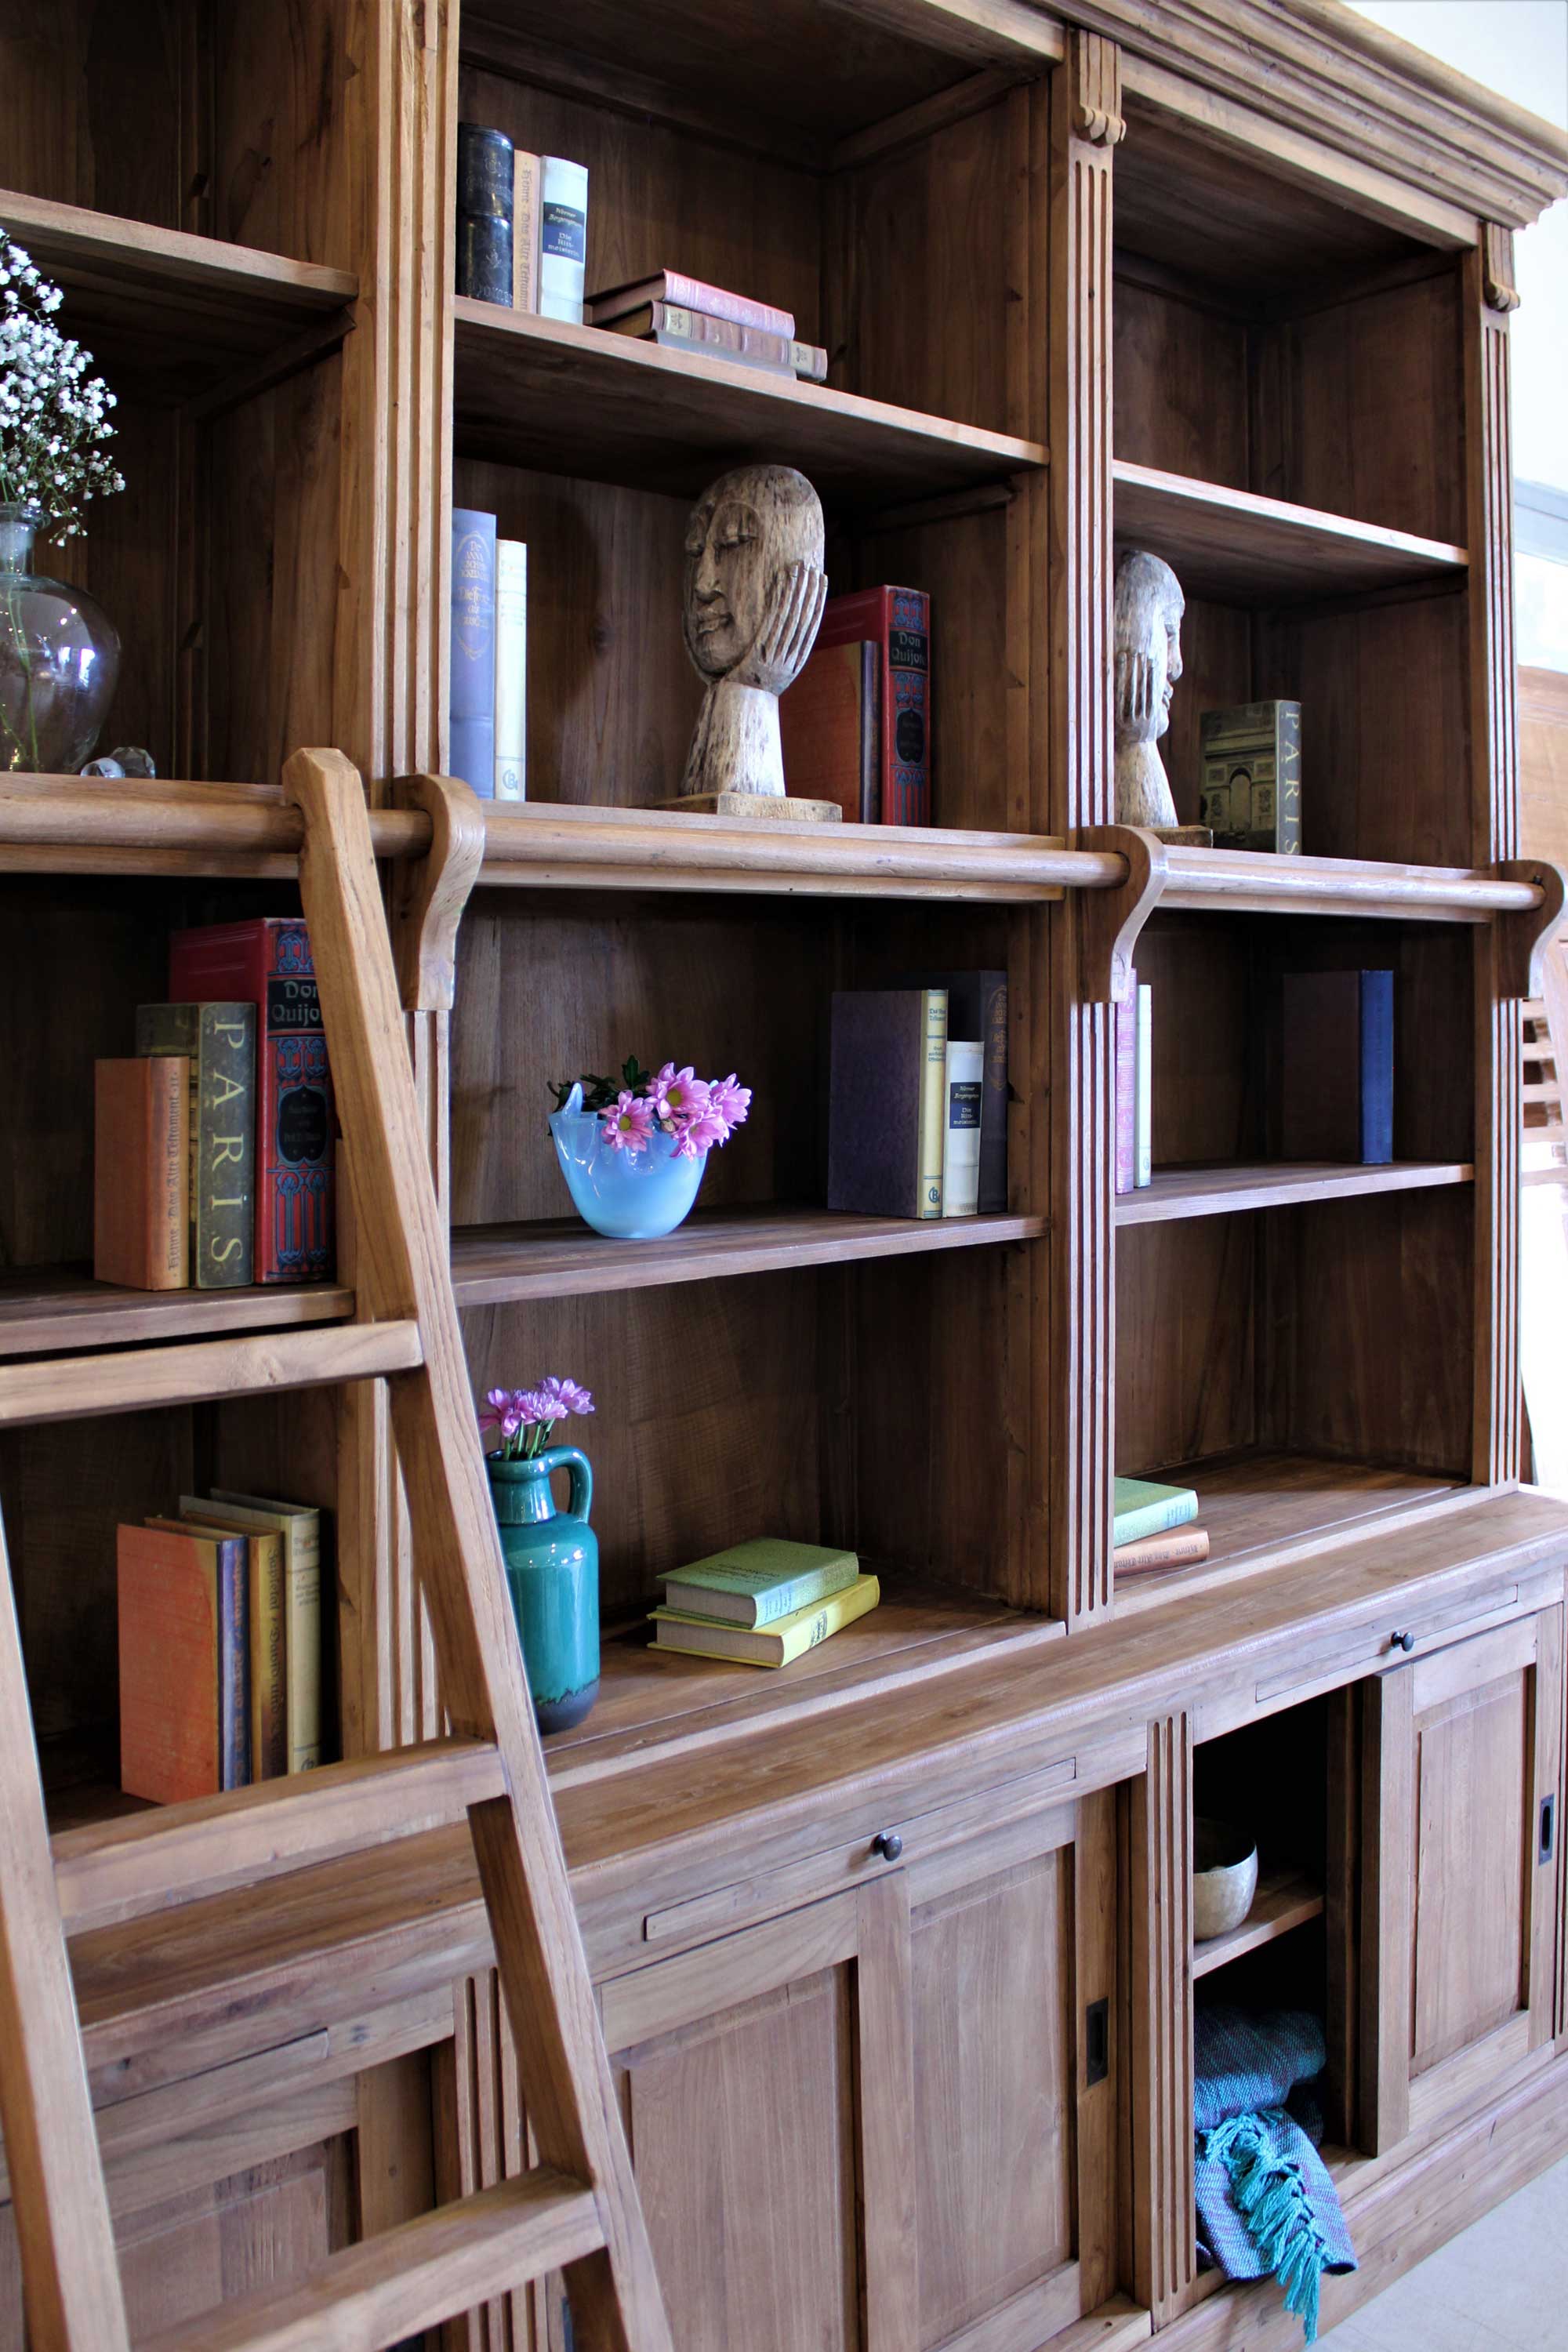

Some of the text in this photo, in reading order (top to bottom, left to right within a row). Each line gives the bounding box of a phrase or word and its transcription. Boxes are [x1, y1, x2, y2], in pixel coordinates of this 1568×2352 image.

[898, 631, 921, 647] Don
[1284, 710, 1300, 854] PARIS
[212, 1018, 245, 1262] PARIS
